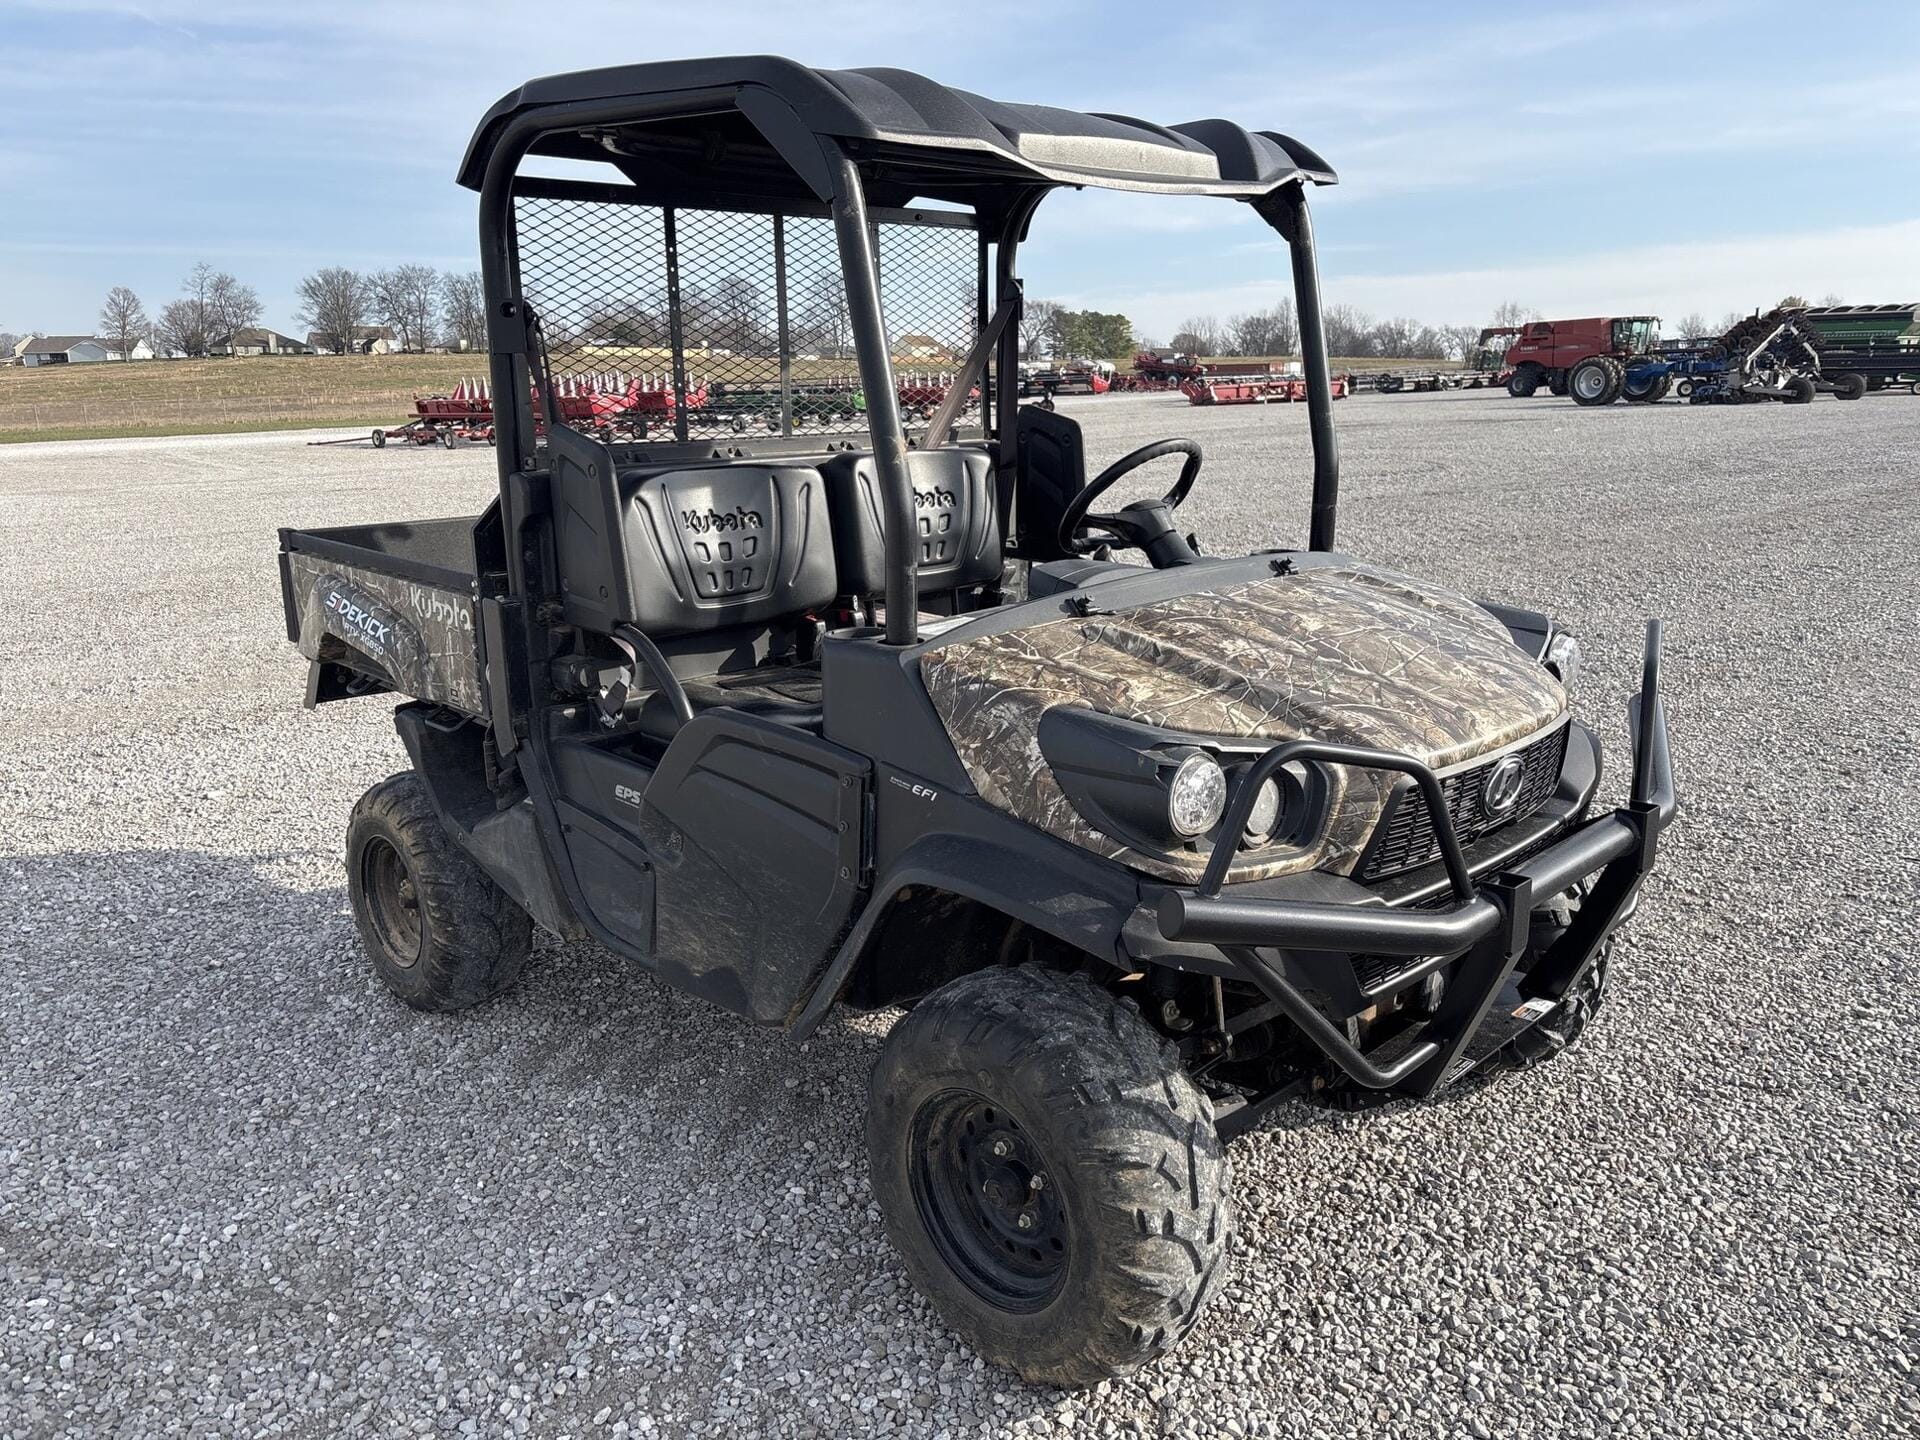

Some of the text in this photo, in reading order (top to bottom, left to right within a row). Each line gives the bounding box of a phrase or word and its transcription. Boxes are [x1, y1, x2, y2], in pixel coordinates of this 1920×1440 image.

[913, 486, 957, 508] bota
[681, 505, 764, 534] Kubota
[325, 591, 390, 644] SIDEKICK
[410, 586, 471, 631] Kubota
[615, 784, 641, 804] EPS
[912, 784, 937, 801] EFI
